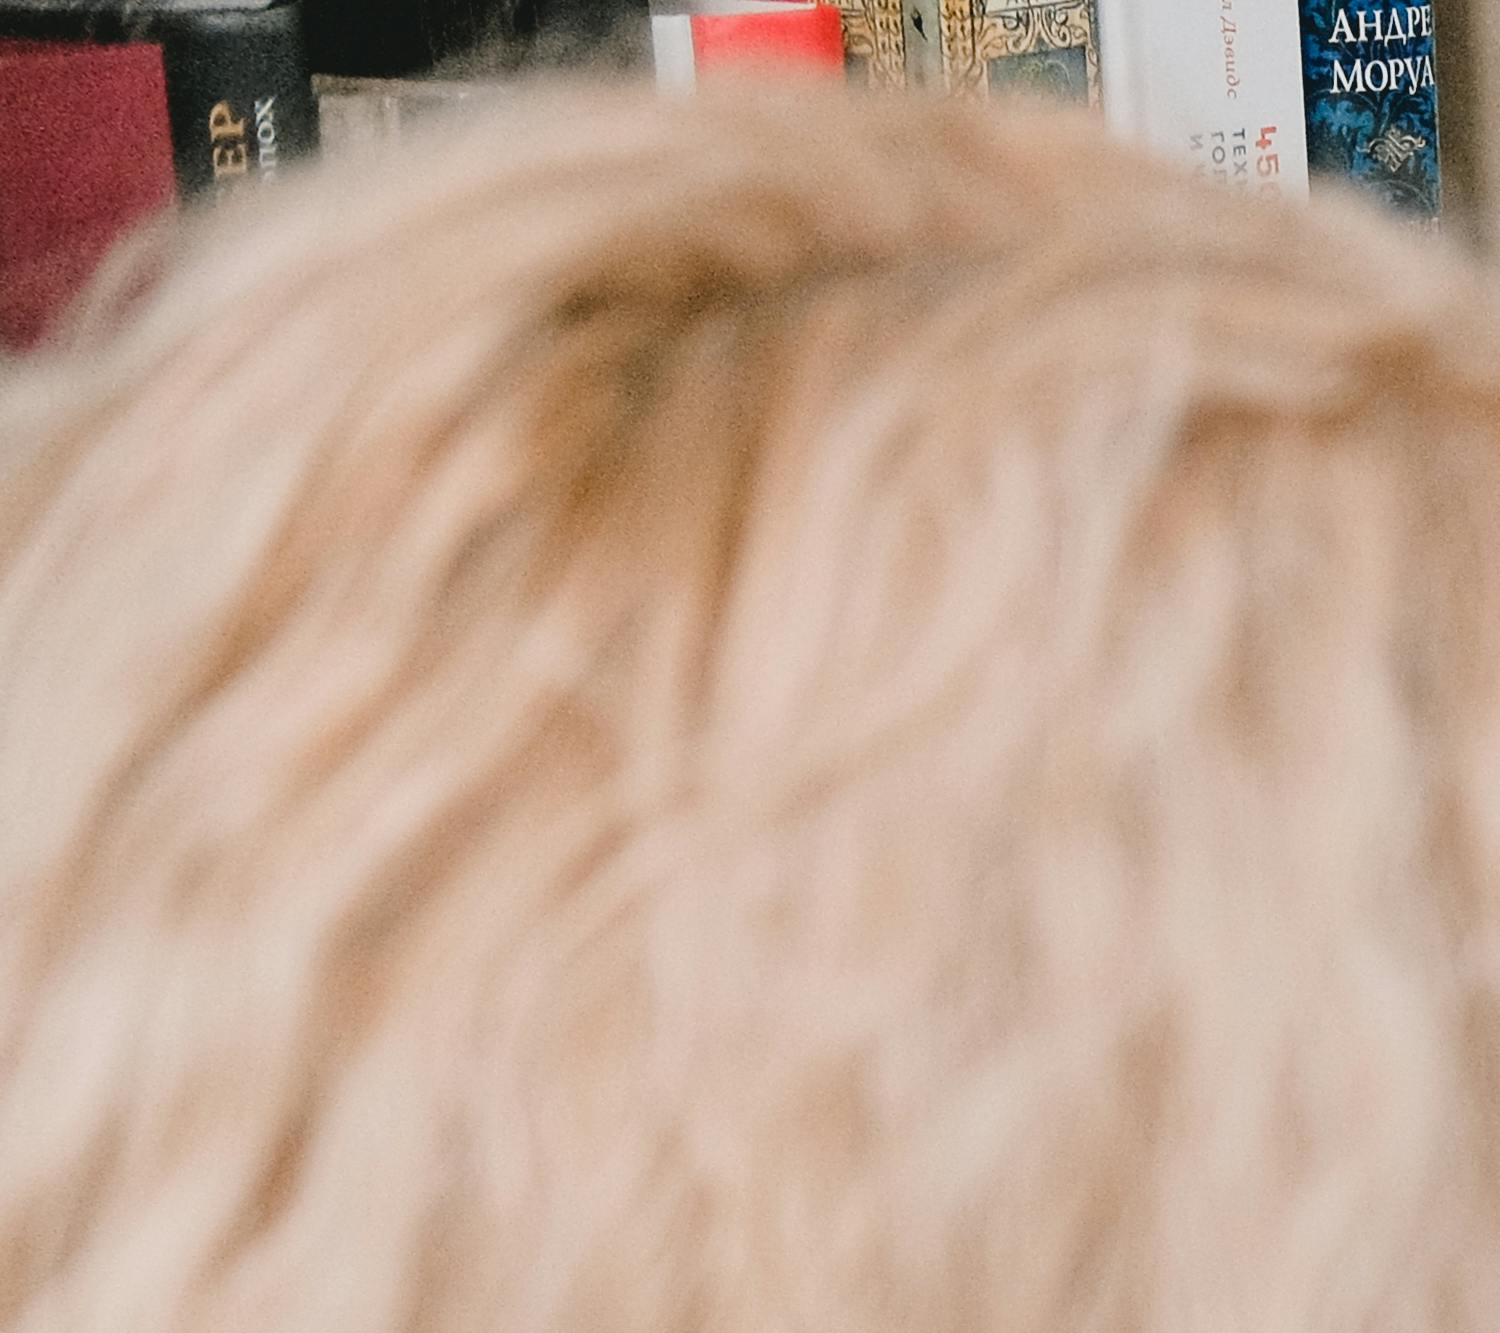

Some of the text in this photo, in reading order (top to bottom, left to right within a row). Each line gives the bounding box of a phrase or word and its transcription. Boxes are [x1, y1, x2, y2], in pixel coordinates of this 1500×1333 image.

[1220, 15, 1240, 99] Дэвидс
[1328, 5, 1432, 47] АНДРЕ
[1330, 55, 1435, 95] МОРУА
[209, 100, 248, 178] ЕР
[1232, 128, 1248, 185] ТЕХ
[1255, 126, 1280, 195] 45
